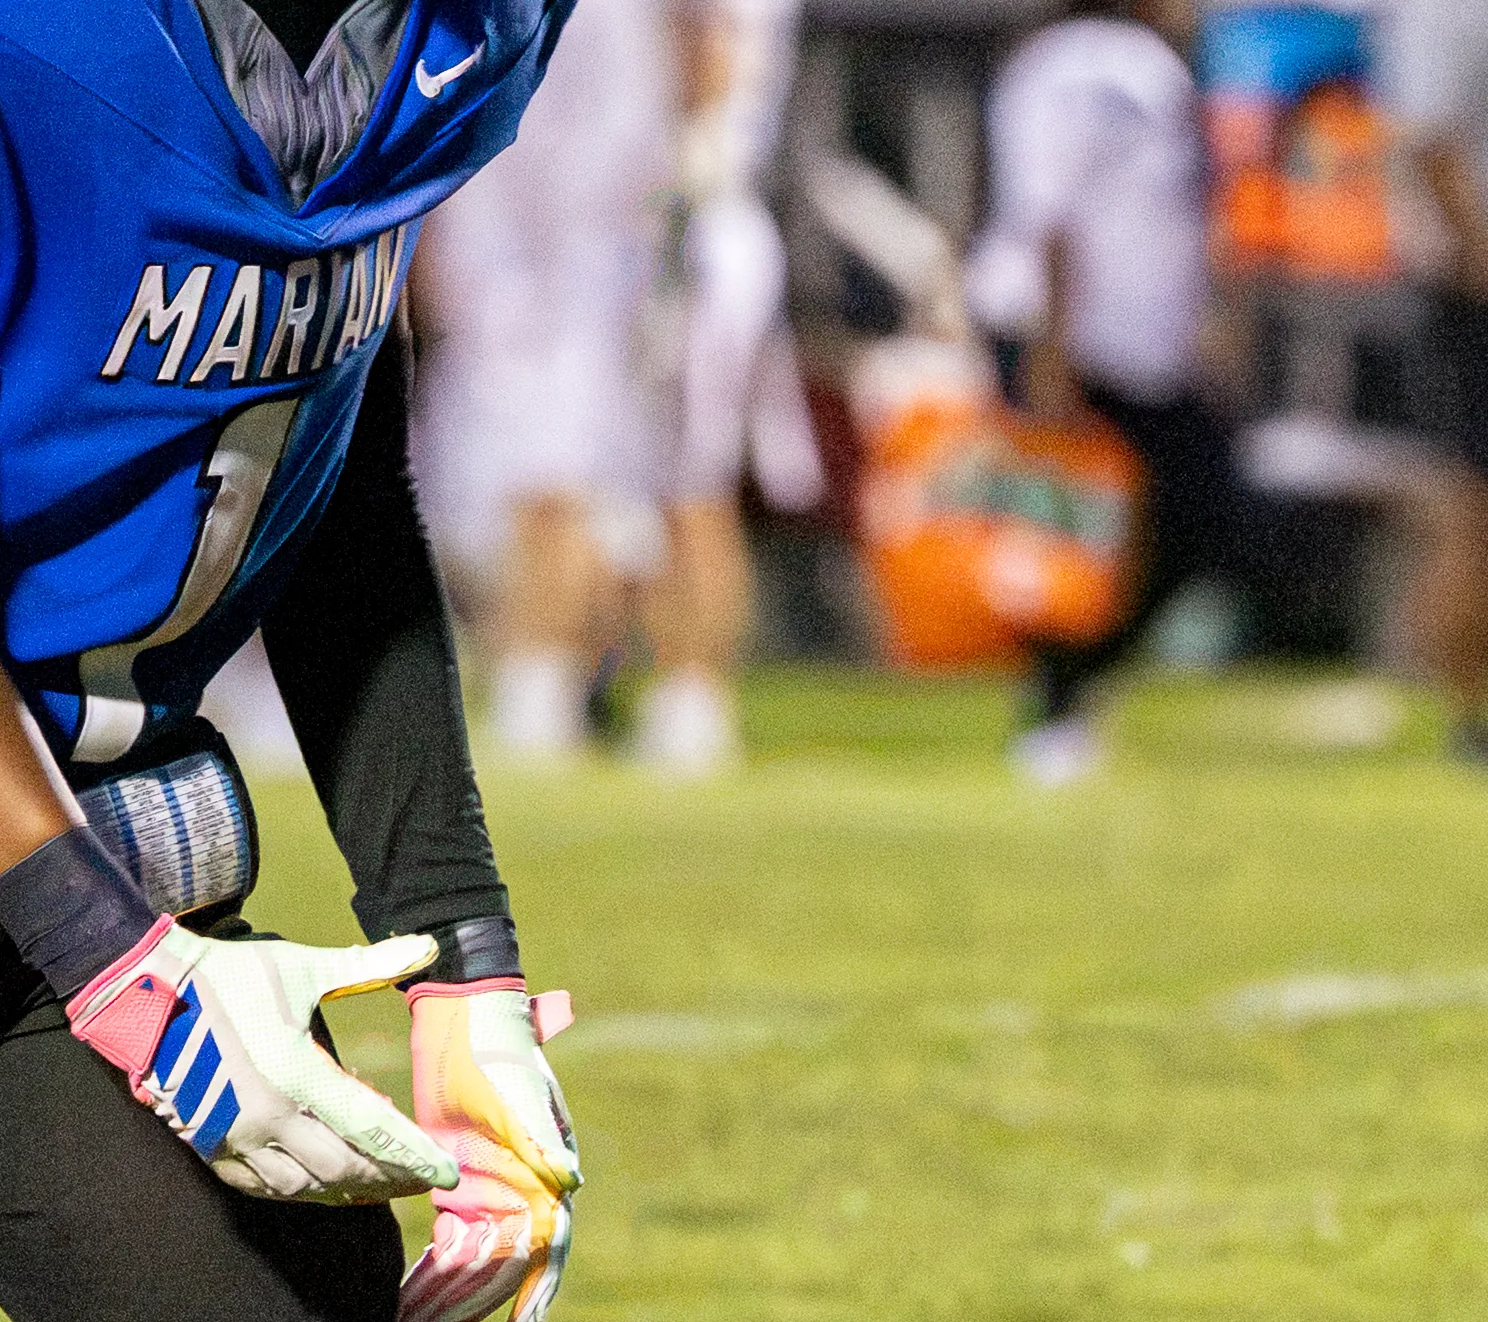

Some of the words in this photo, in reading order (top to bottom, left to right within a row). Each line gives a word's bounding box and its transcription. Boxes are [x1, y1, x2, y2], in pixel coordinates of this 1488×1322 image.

[101, 224, 408, 382] MARIAN
[70, 397, 301, 763] 1
[360, 1125, 438, 1179] ADIZERO
